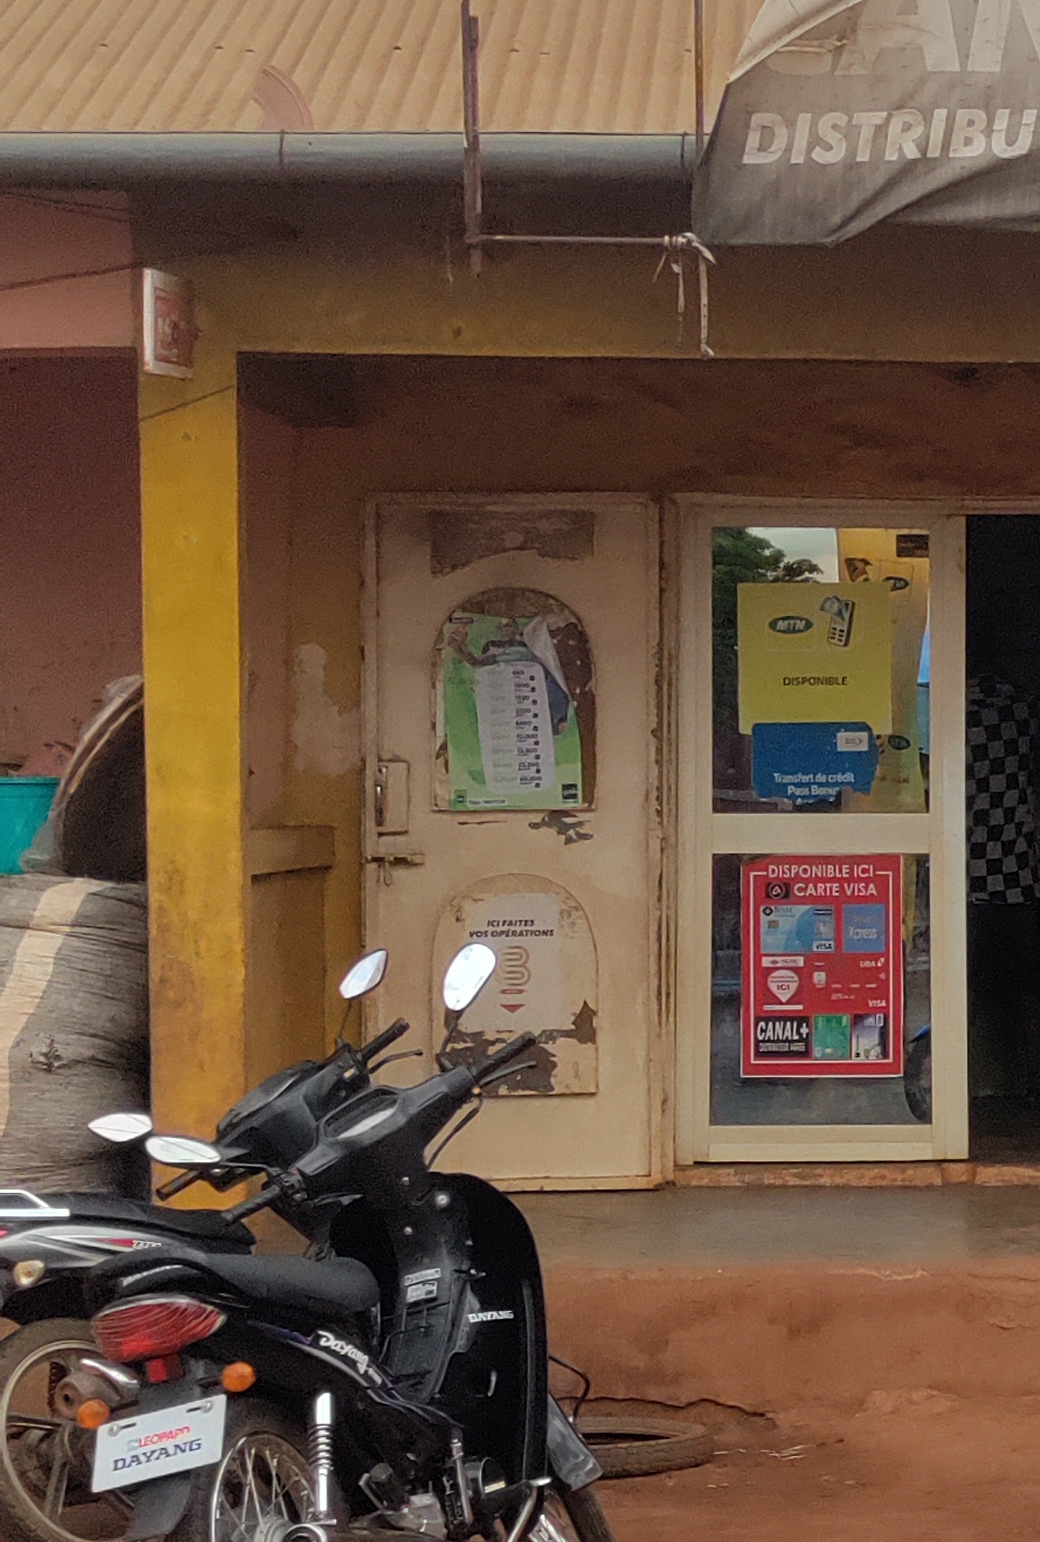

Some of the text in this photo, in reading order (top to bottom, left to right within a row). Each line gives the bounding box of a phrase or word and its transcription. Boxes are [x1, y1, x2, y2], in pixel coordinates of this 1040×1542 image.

[782, 676, 848, 687] DISPONIBLE
[773, 772, 814, 783] Transfert
[815, 773, 827, 783] de
[768, 864, 874, 879] DISPONIBLE ICI
[794, 882, 878, 897] CARTE VISA
[486, 919, 535, 928] ICI FAITES
[469, 928, 555, 938] VOS OPÉRATIONS
[757, 1021, 809, 1040] CANAL+
[467, 1310, 515, 1323] DAYANG
[112, 1437, 202, 1472] DAYANG
